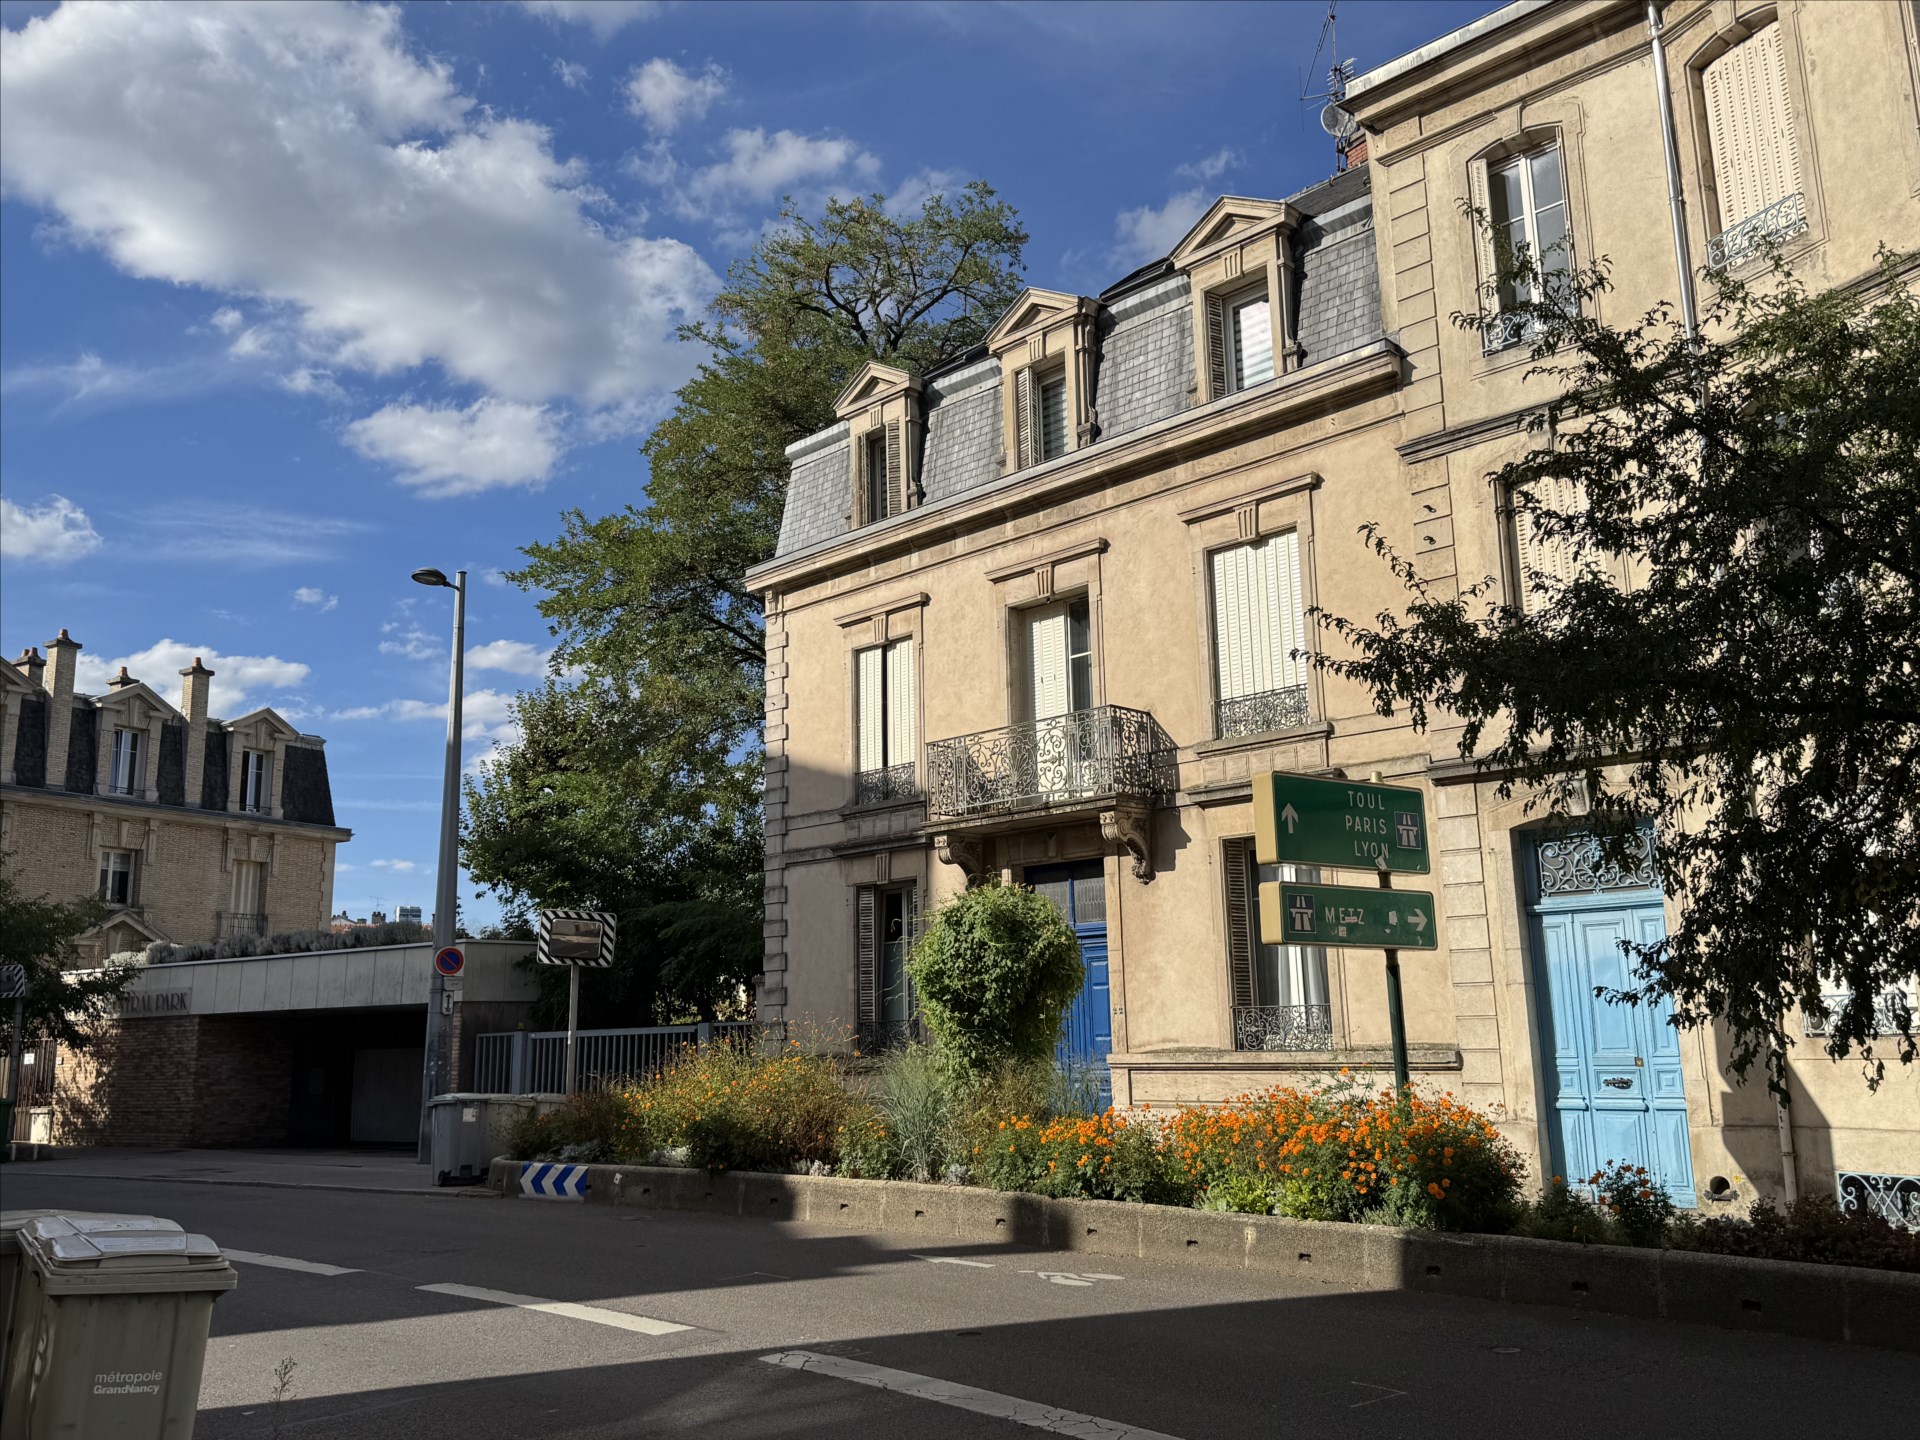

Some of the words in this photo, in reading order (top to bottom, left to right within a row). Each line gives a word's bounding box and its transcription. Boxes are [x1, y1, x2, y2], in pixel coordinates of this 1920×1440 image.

[1347, 791, 1385, 811] TOUL
[1345, 815, 1387, 835] PARIS
[1354, 840, 1389, 859] LYON
[1324, 906, 1365, 925] METZ
[155, 991, 187, 1011] PARK
[94, 1369, 163, 1384] métropole
[93, 1384, 160, 1395] GrandNancy
